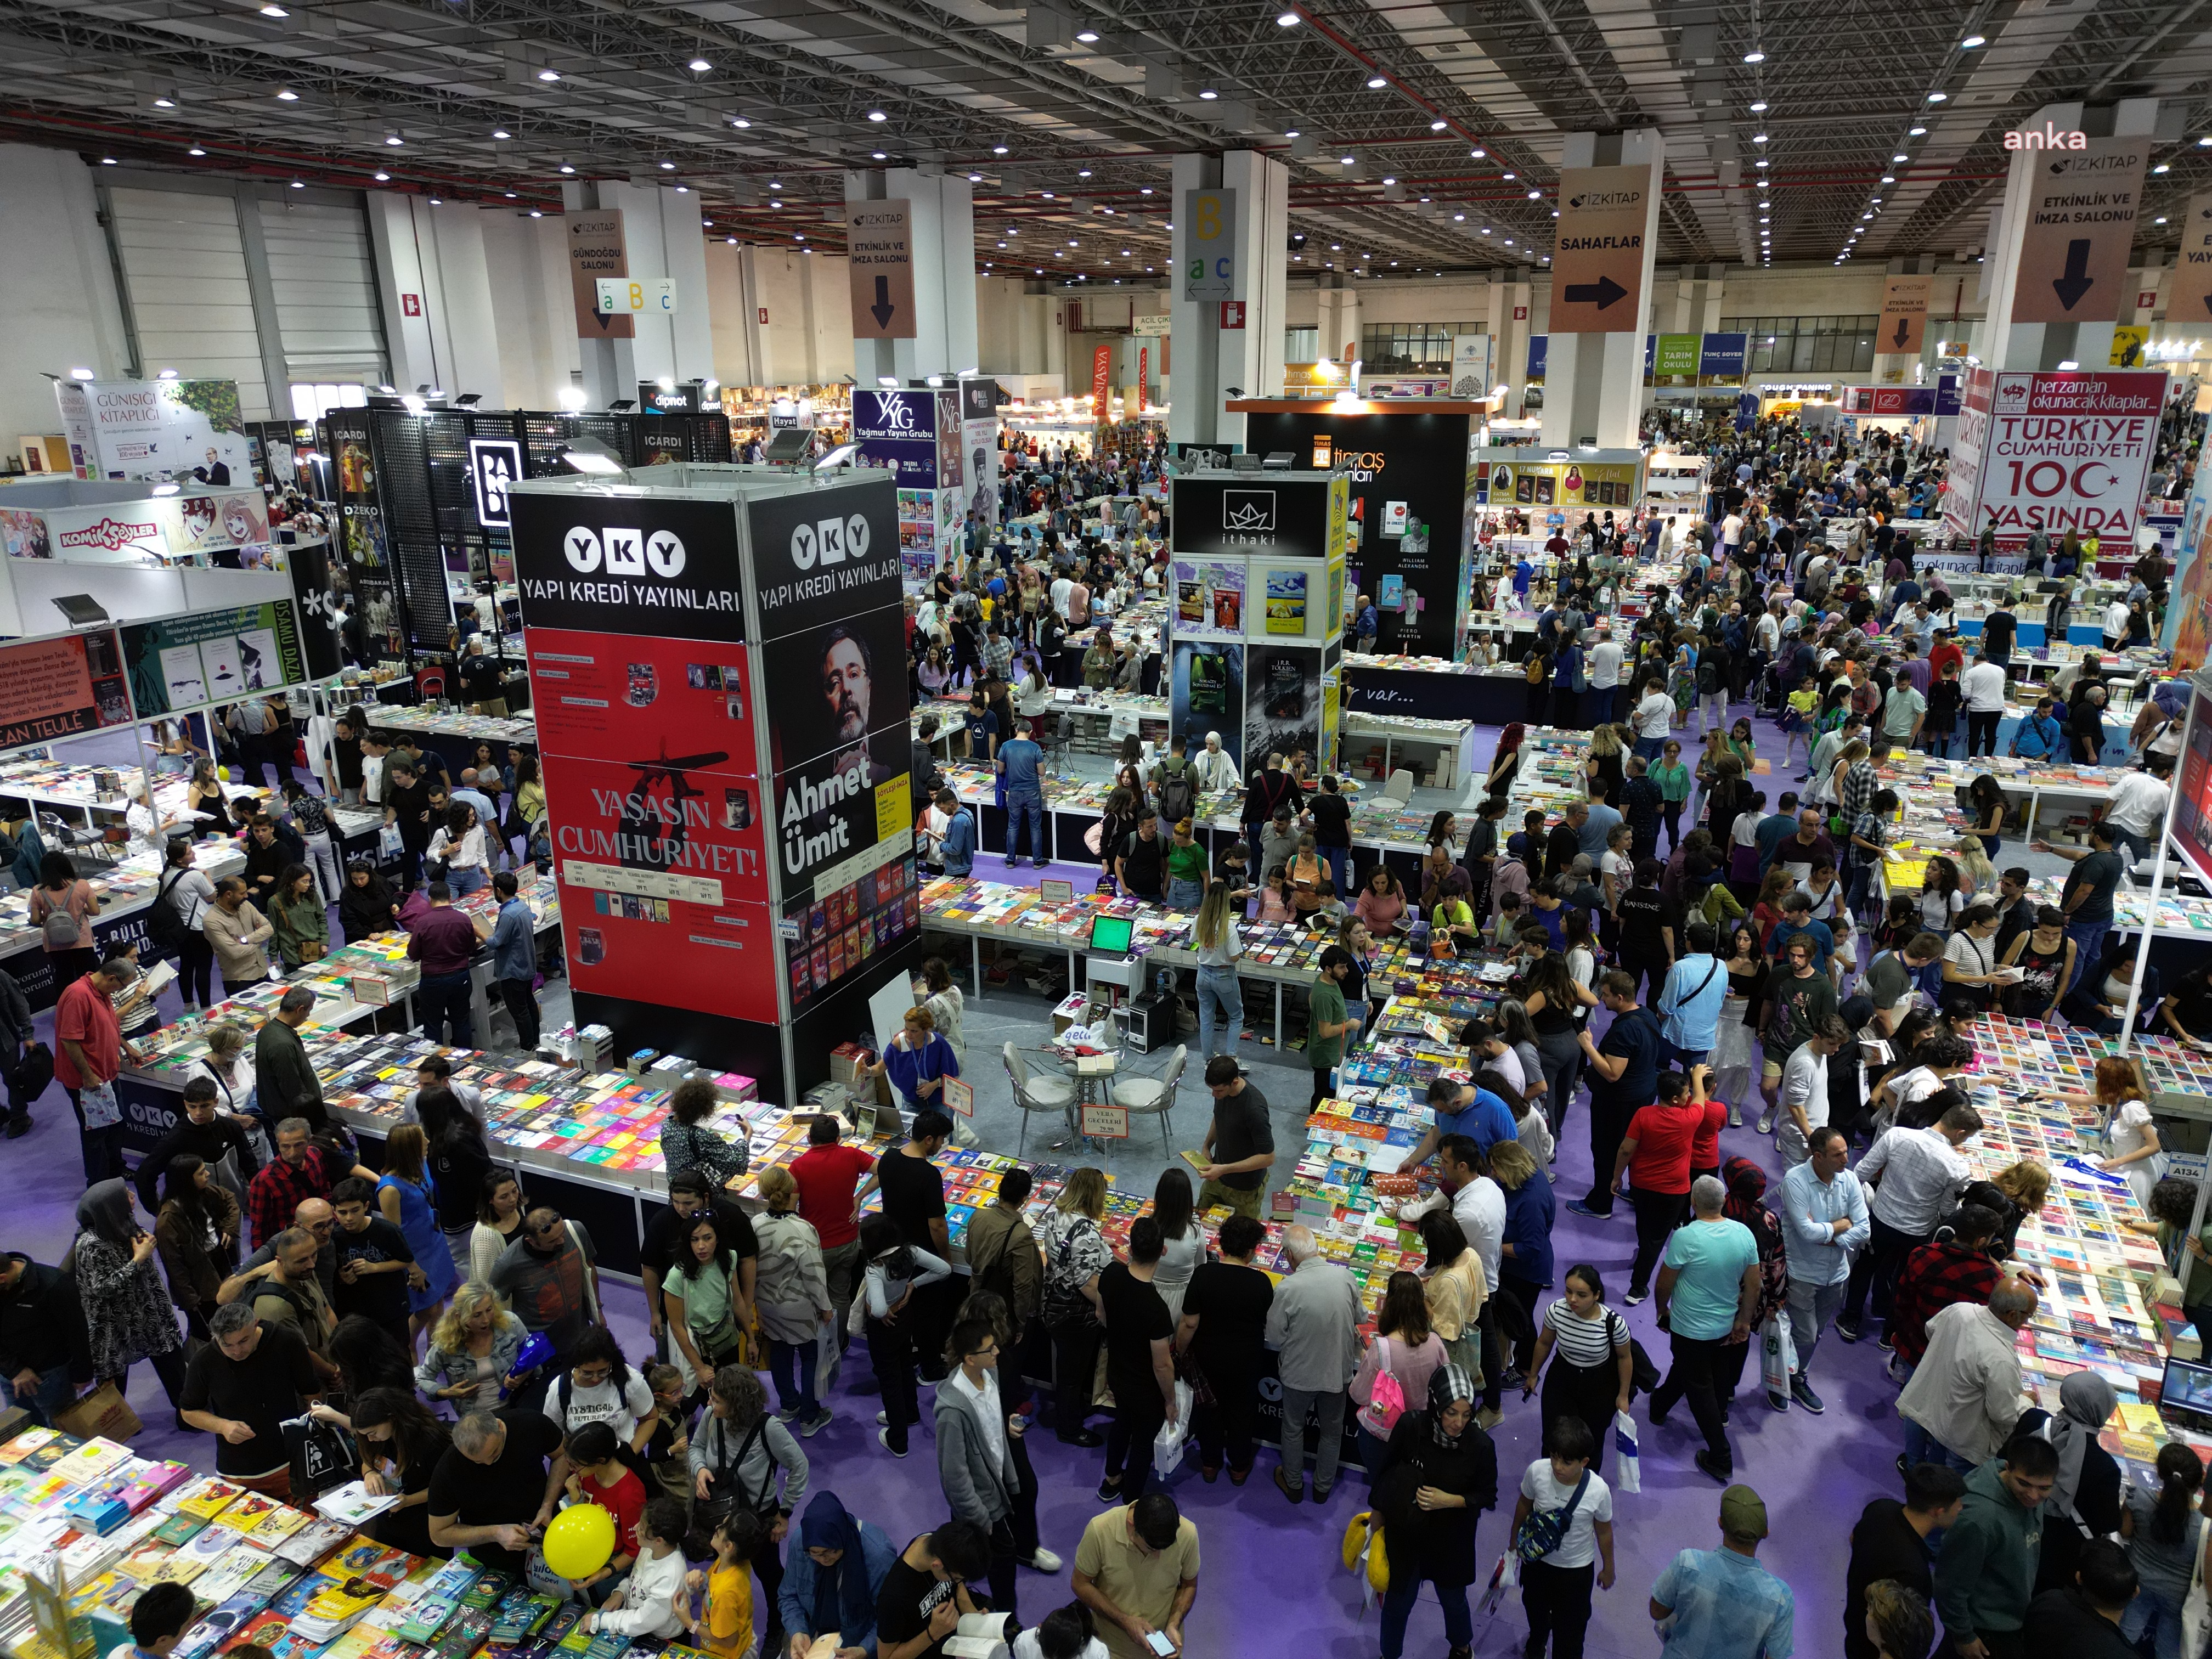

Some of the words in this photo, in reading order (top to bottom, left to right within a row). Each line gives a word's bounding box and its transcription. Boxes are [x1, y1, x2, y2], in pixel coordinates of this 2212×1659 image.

[2072, 154, 2137, 171] İZKİTAP
[1588, 191, 1639, 205] İZKİTAP
[2044, 191, 2108, 208] ETKİNLİK
[2113, 193, 2131, 204] VE
[866, 213, 902, 224] İZKİTAP
[1197, 196, 1222, 241] B
[2035, 212, 2069, 225] İMZA
[2074, 210, 2134, 223] SALONU
[855, 240, 891, 251] ETKİNLİK
[1561, 236, 1640, 250] SAHAFLAR
[573, 247, 620, 258] GÜNDOĞDU
[852, 253, 872, 263] İMZA
[874, 255, 908, 263] SALONU
[2188, 252, 2212, 263] YAY
[581, 261, 614, 269] SALONU
[1190, 258, 1204, 279] a
[1216, 257, 1230, 279] c
[604, 295, 613, 309] a
[629, 283, 644, 309] B
[662, 295, 670, 309] c
[1158, 315, 1171, 324] ÇIKI
[1095, 351, 1108, 411] YENİASYA
[1288, 369, 1312, 381] timaş
[2035, 378, 2058, 393] her
[2059, 381, 2107, 393] zaman
[97, 391, 157, 407] GÜNIŞIĞI
[656, 394, 687, 409] dipnot
[701, 399, 721, 411] dipnot
[2033, 394, 2097, 409] okunacak
[100, 407, 160, 423] KİTAPLIĞI
[774, 417, 797, 427] Hayat
[334, 430, 366, 439] ICARDI
[857, 428, 885, 438] Yağmur
[886, 428, 907, 439] Yayın
[909, 429, 933, 438] Grubu
[2001, 418, 2146, 442] TÜRKİYE
[645, 436, 682, 447] ICARDI
[1997, 442, 2142, 458] CUMHURİYETİ
[180, 494, 250, 512] orange
[344, 504, 379, 516] DŽEKO
[796, 523, 865, 558] YKY
[1222, 533, 1276, 546] ithaki
[571, 538, 676, 566] YKY
[760, 585, 792, 611] YAPI
[795, 569, 836, 601] KREDİ
[838, 557, 900, 589] YAYINLARI
[522, 579, 564, 600] YAPI
[571, 581, 629, 604] KREDİ
[633, 585, 740, 612] YAYINLARI
[275, 600, 296, 645] OSAMU
[284, 646, 302, 684] DAZAI
[32, 710, 84, 738] TEULÉ
[782, 757, 872, 829] Ahmet
[877, 778, 908, 798] SÖYLEŞİ-İMZA
[591, 788, 710, 828] YAŞASIN
[558, 825, 758, 877] CUMHURİYET!
[785, 814, 849, 874] Ümit
[544, 896, 554, 905] A136
[1087, 1117, 1122, 1125] GECELERİ
[133, 1124, 159, 1137] KREDİ
[2173, 1167, 2199, 1177] A134
[568, 1403, 613, 1415] MYSTICAL
[574, 1413, 606, 1422] FUTURES
